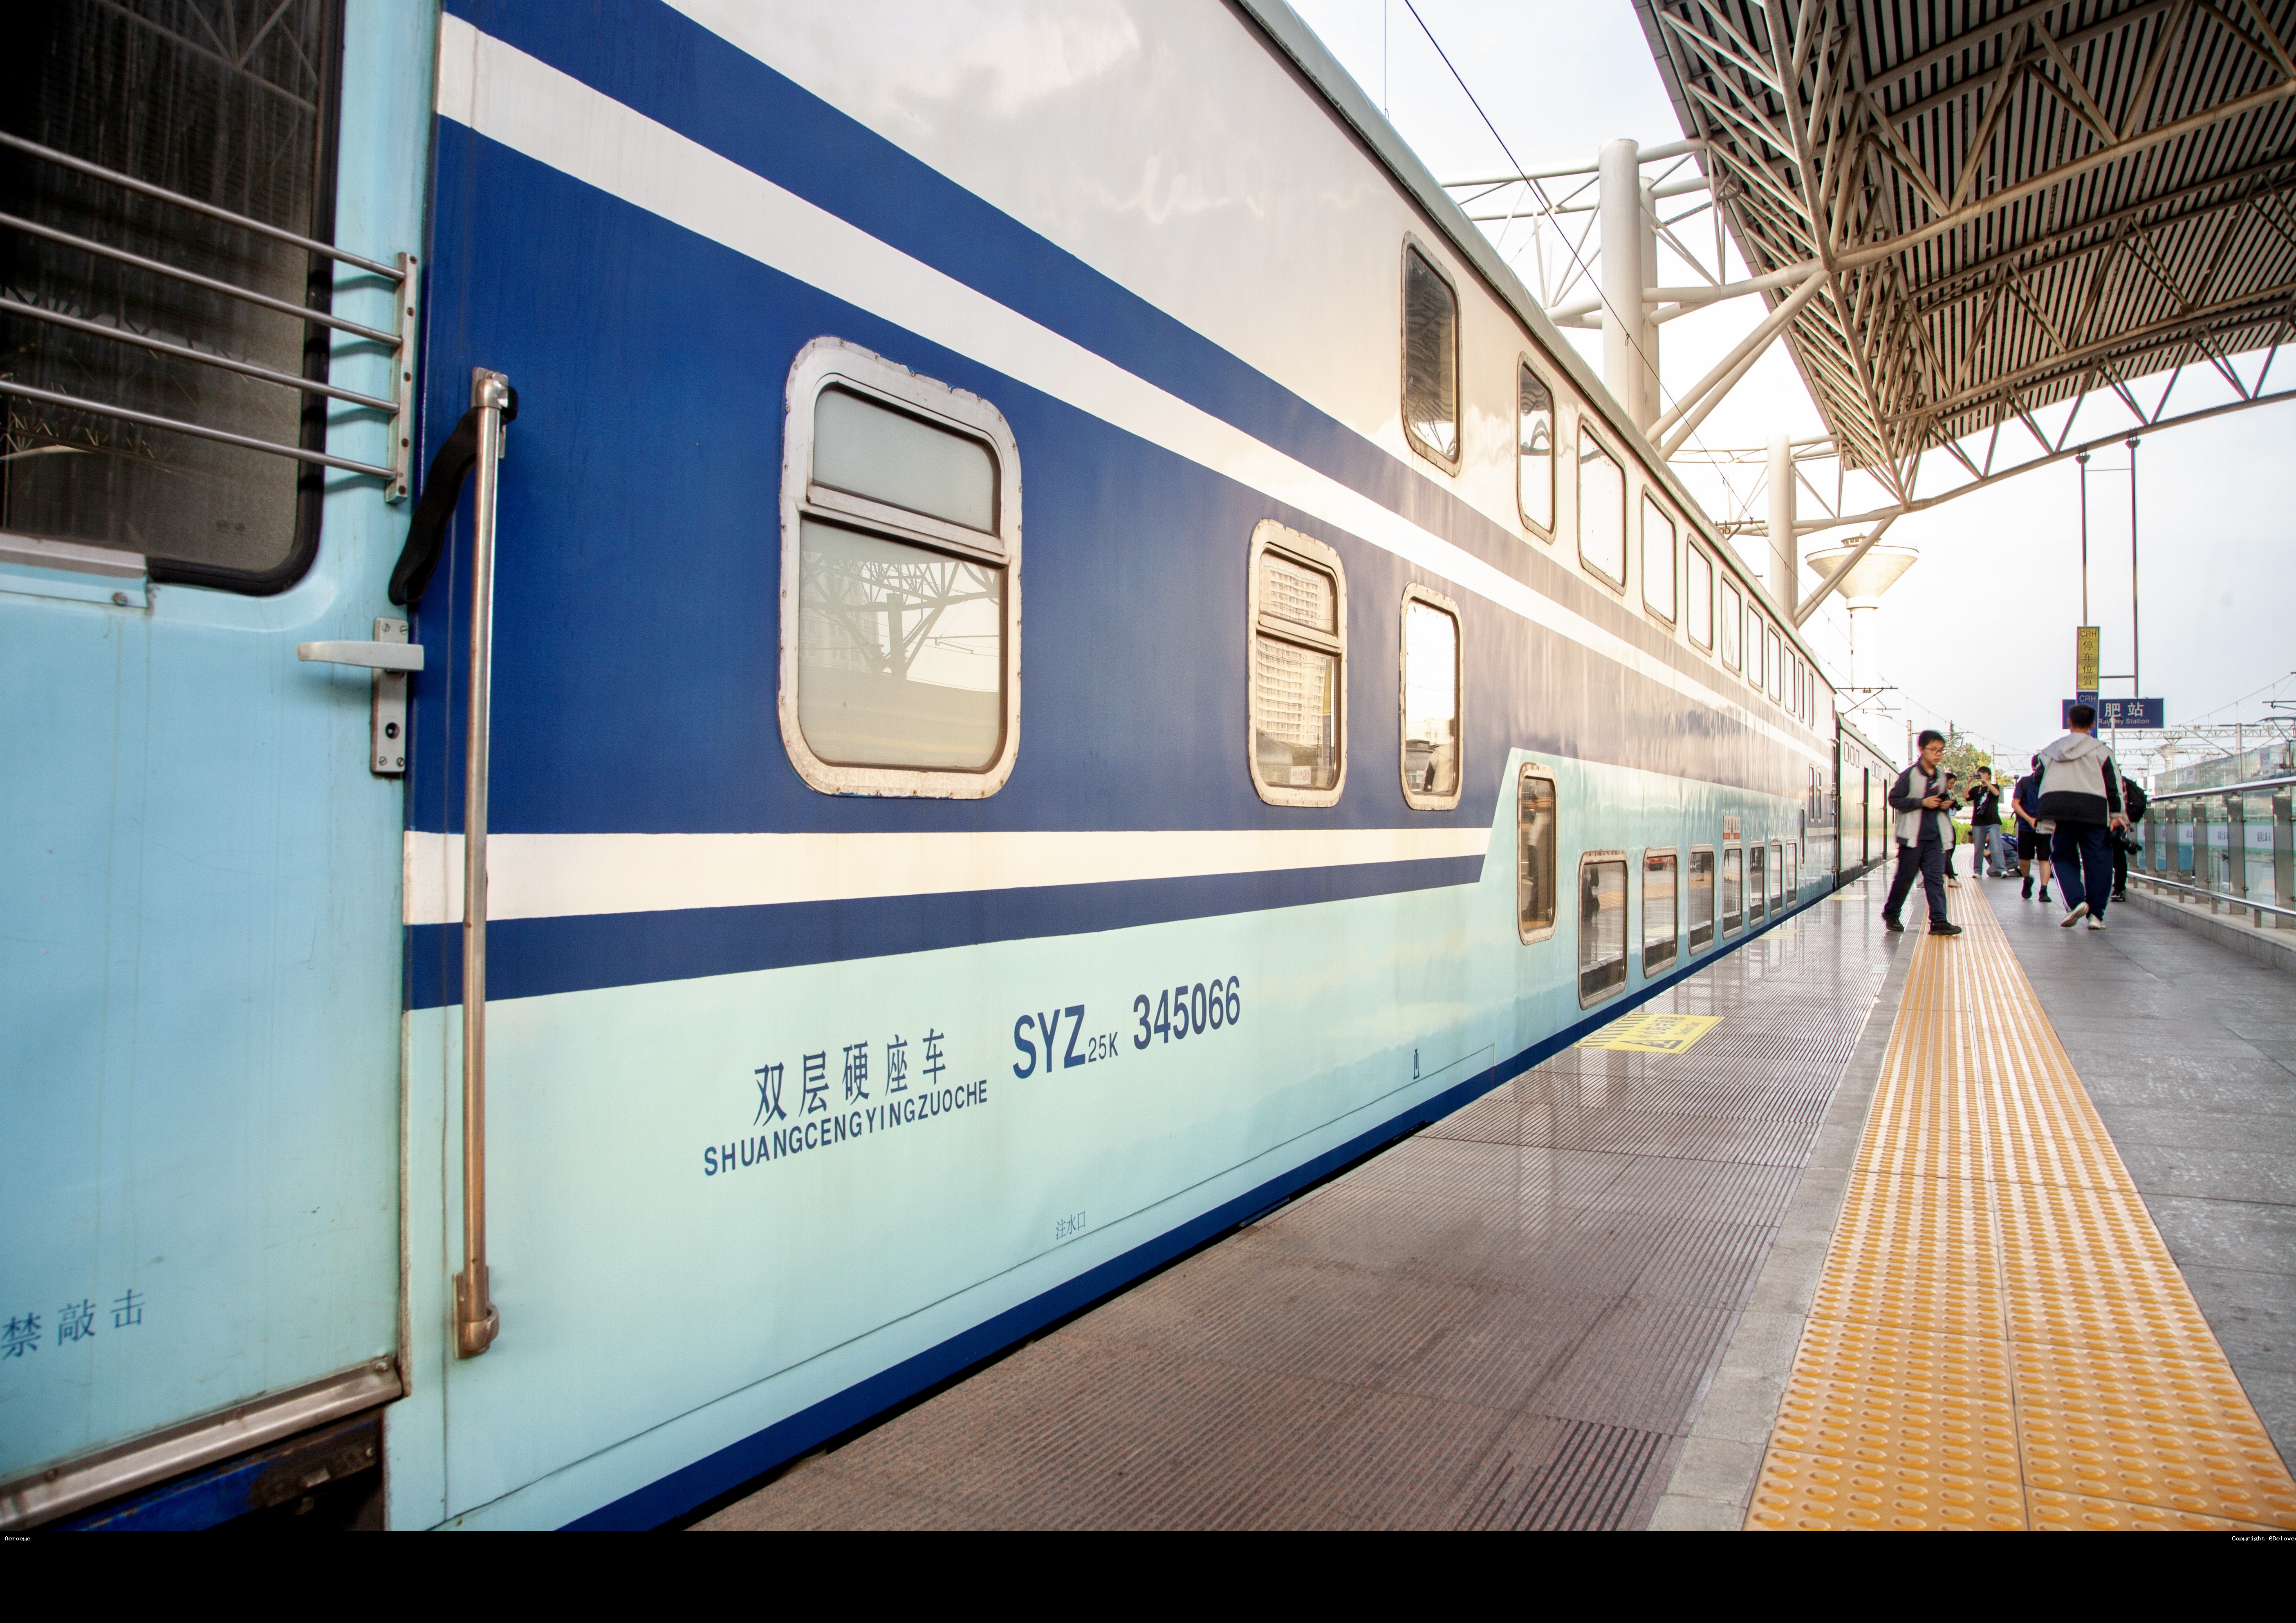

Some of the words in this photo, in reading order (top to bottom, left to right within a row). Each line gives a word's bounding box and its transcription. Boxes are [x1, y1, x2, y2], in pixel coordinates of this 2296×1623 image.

[2083, 640, 2094, 685] 停车位置
[1133, 975, 1241, 1051] 345066
[753, 1028, 946, 1127] 双层硬座车
[704, 1080, 988, 1177] SHUANGCENGYINGZUOCHE
[1056, 1211, 1085, 1240] 注水口
[1, 1289, 146, 1360] 禁敲击
